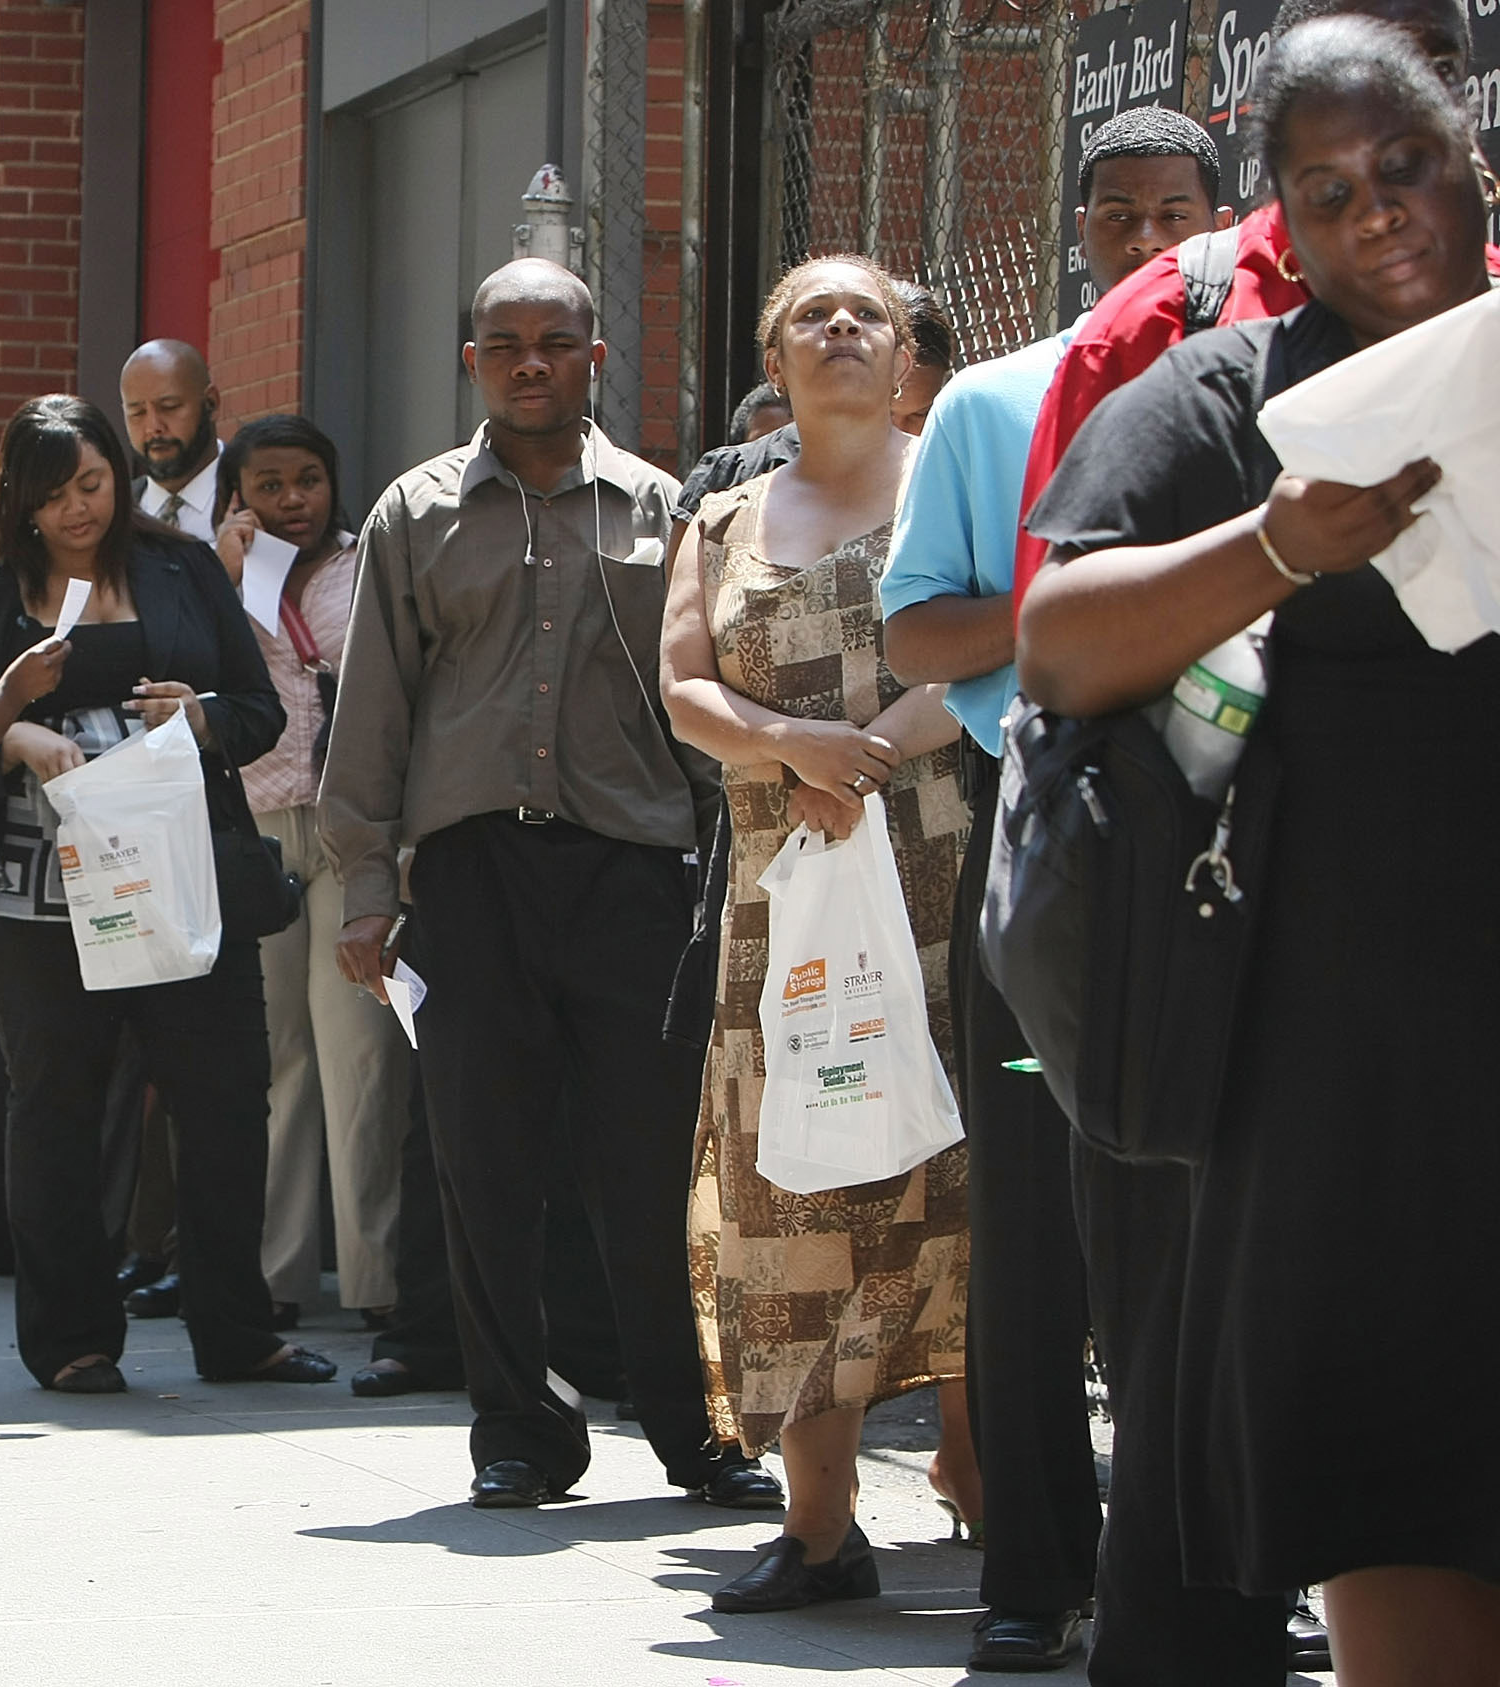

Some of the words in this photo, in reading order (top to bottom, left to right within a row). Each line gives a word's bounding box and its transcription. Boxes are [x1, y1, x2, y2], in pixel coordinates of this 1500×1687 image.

[1071, 39, 1128, 118] Early
[1128, 19, 1177, 100] Bird
[1238, 158, 1261, 199] UP
[789, 966, 820, 983] Public
[790, 976, 825, 993] Storage
